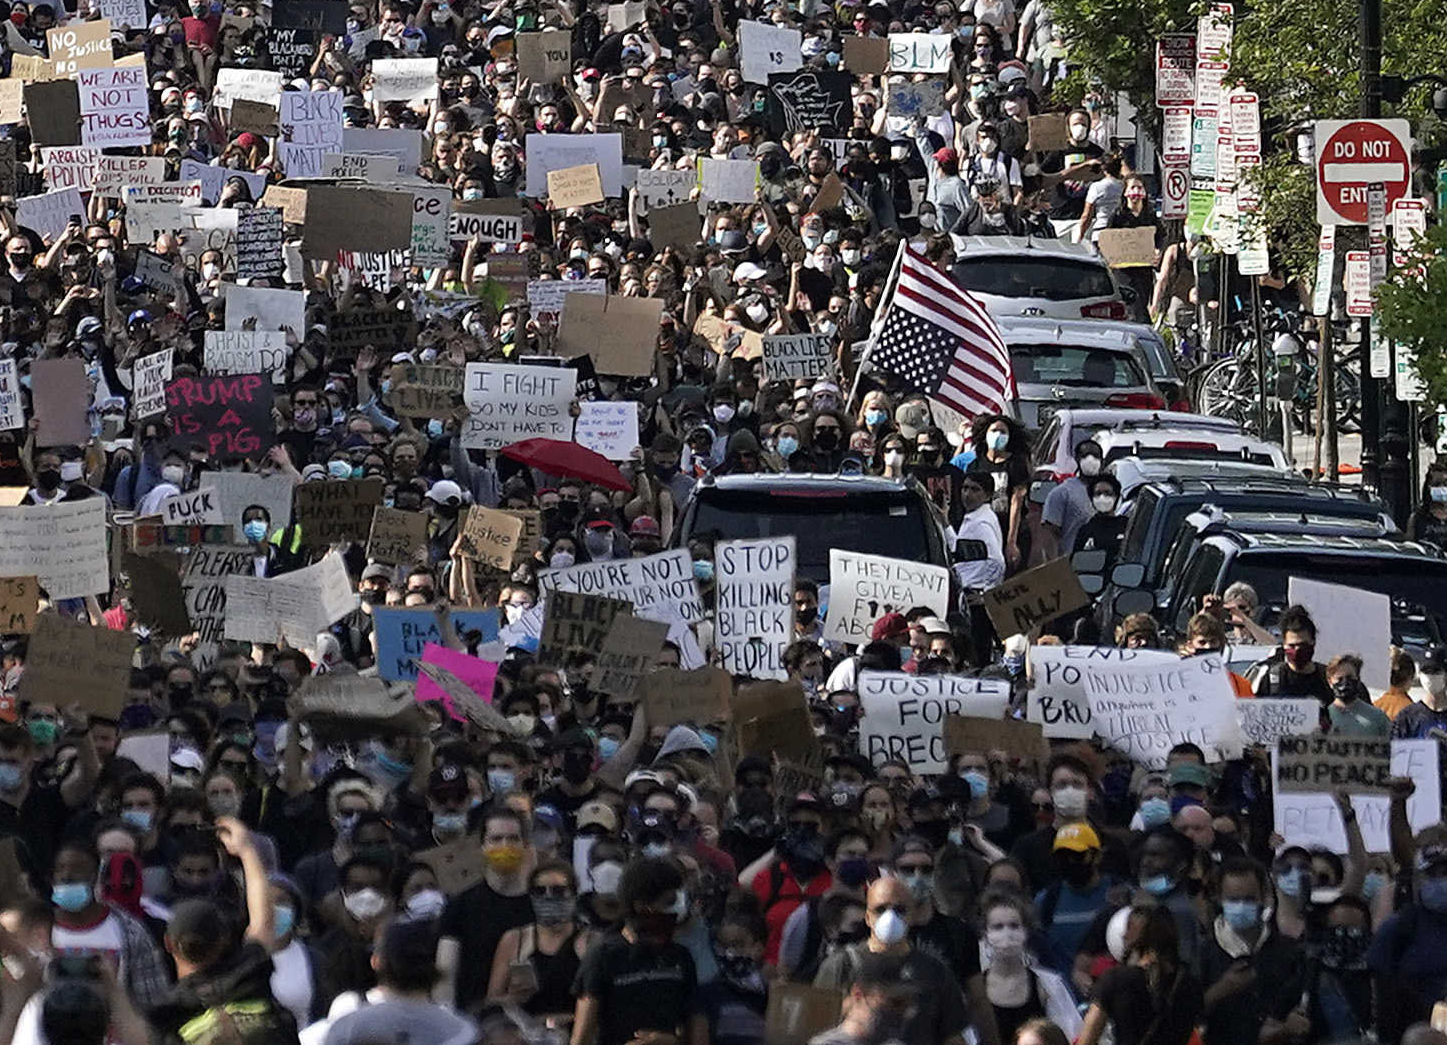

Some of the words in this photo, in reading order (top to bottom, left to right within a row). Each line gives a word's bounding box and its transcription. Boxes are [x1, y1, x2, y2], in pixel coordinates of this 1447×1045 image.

[103, 5, 140, 16] LIVES
[52, 31, 77, 51] NO
[67, 36, 113, 57] JUSTICE
[546, 48, 569, 62] YOU
[889, 42, 951, 69] BLM
[1161, 57, 1193, 68] ROUTE
[79, 70, 105, 87] WE
[111, 69, 143, 85] ARE
[91, 88, 138, 107] NOT
[290, 93, 341, 121] BLACK
[83, 112, 147, 132] THUGS
[292, 121, 340, 145] LIVES
[48, 148, 97, 165] ABOLISH
[1334, 142, 1355, 158] DO
[1362, 141, 1391, 158] NOT
[98, 158, 148, 172] KILLER
[342, 156, 368, 168] END
[127, 187, 143, 196] MY
[147, 184, 201, 198] EXECUTION
[449, 216, 518, 241] ENOUGH
[762, 339, 799, 358] BLACK
[802, 336, 832, 356] LIVES
[259, 349, 285, 371] DO
[764, 359, 828, 378] MATTER
[165, 375, 263, 407] TRUMP
[472, 371, 492, 392] I
[502, 374, 561, 396] FIGHT
[469, 401, 493, 415] SO
[499, 402, 518, 415] MY
[525, 402, 559, 417] KIDS
[173, 413, 202, 436] IS
[217, 408, 243, 428] A
[513, 422, 546, 433] HAVE
[550, 422, 565, 433] TO
[208, 427, 261, 456] PIG
[168, 494, 215, 520] FUCK
[470, 509, 485, 522] No
[466, 522, 512, 547] Justice
[641, 555, 684, 579] NOT
[721, 544, 790, 575] STOP
[838, 558, 891, 580] THEY
[659, 577, 697, 601] NOT
[718, 582, 792, 608] KILLING
[855, 580, 904, 599] GIVE
[902, 587, 915, 604] A
[1013, 590, 1062, 630] ALLY
[401, 620, 466, 639] BLAK
[719, 610, 785, 637] BLACK
[720, 640, 788, 674] PEOPLE
[866, 677, 1000, 695] JUSTICE
[1087, 665, 1195, 695] INJUSTICE
[897, 699, 963, 726] FOR
[1278, 737, 1309, 753] NO
[1312, 739, 1390, 755] JUSTICE
[1278, 764, 1309, 781] NO
[1312, 762, 1391, 786] PEACE
